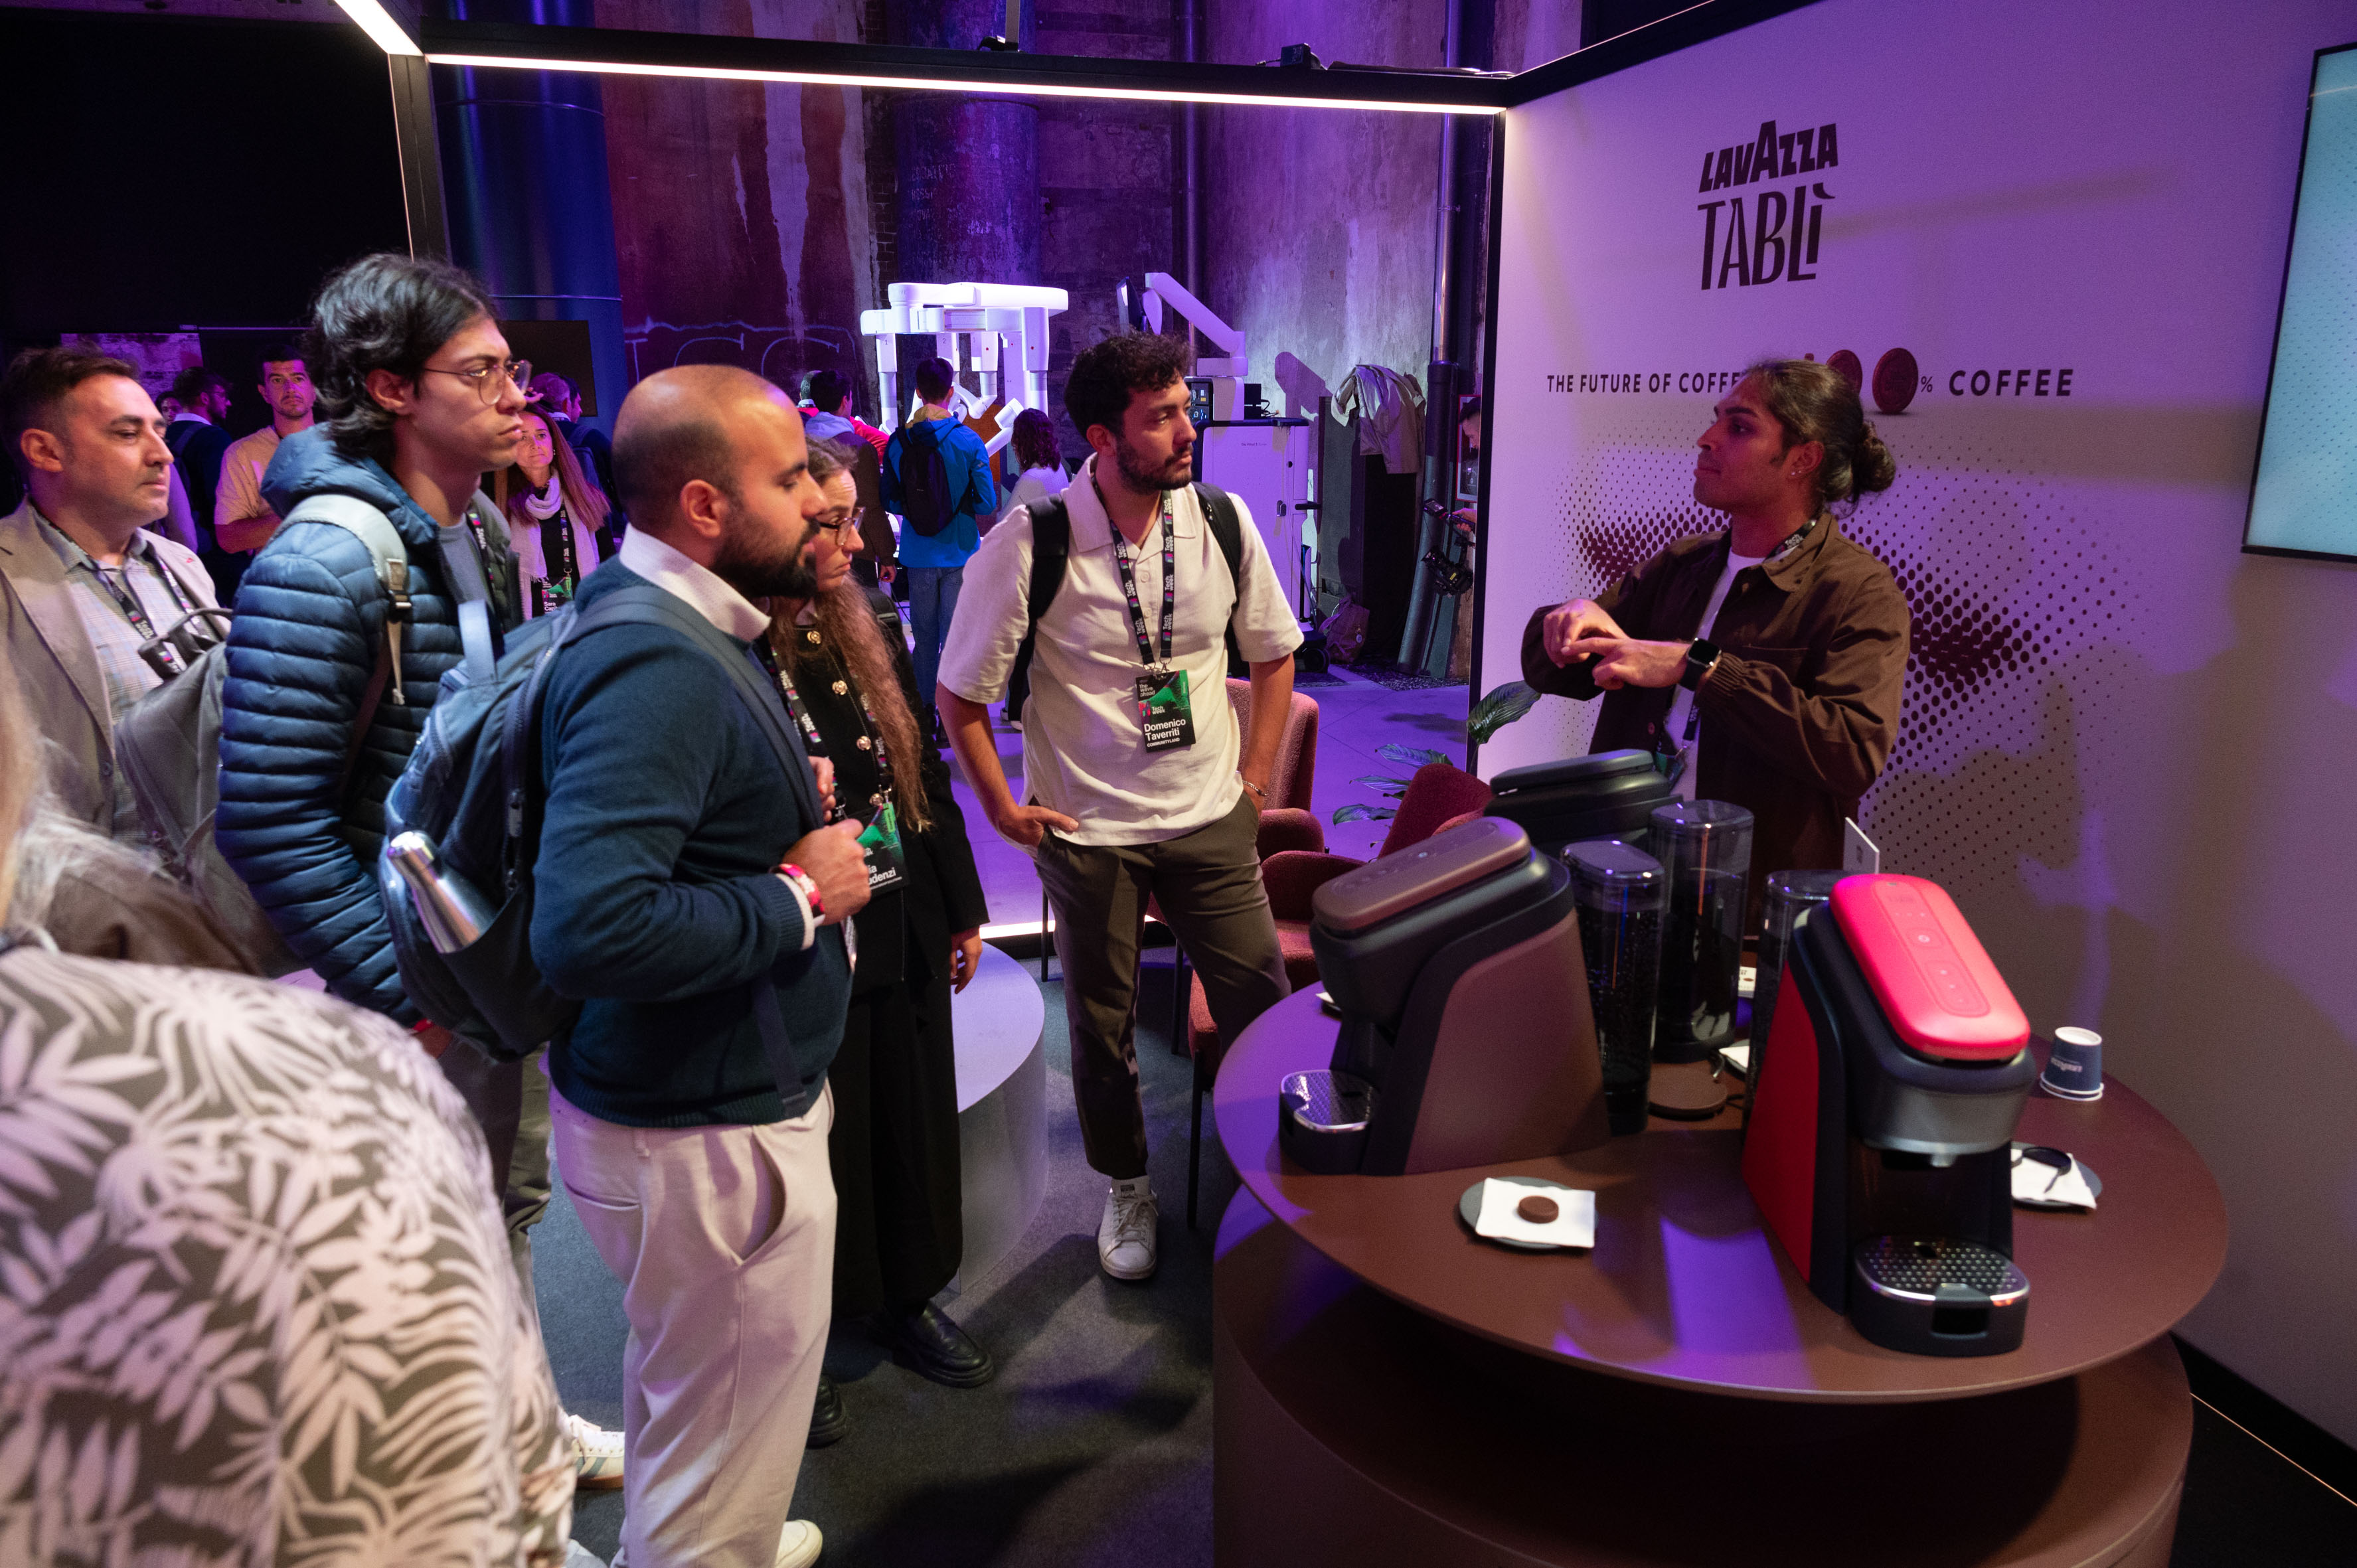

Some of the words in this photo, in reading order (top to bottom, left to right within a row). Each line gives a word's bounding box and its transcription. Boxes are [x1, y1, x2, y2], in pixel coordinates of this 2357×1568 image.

[1698, 119, 1839, 194] LAVAZZA
[1547, 374, 1574, 393] THE
[1580, 373, 1641, 393] FUTURE
[1649, 372, 1672, 393] OF
[1678, 372, 1742, 394] COFFE
[1949, 368, 2073, 397] COFFEE
[1144, 719, 1186, 732] Domenico
[1145, 728, 1180, 741] Taverriti
[1147, 738, 1180, 747] COMMUNITYLAND
